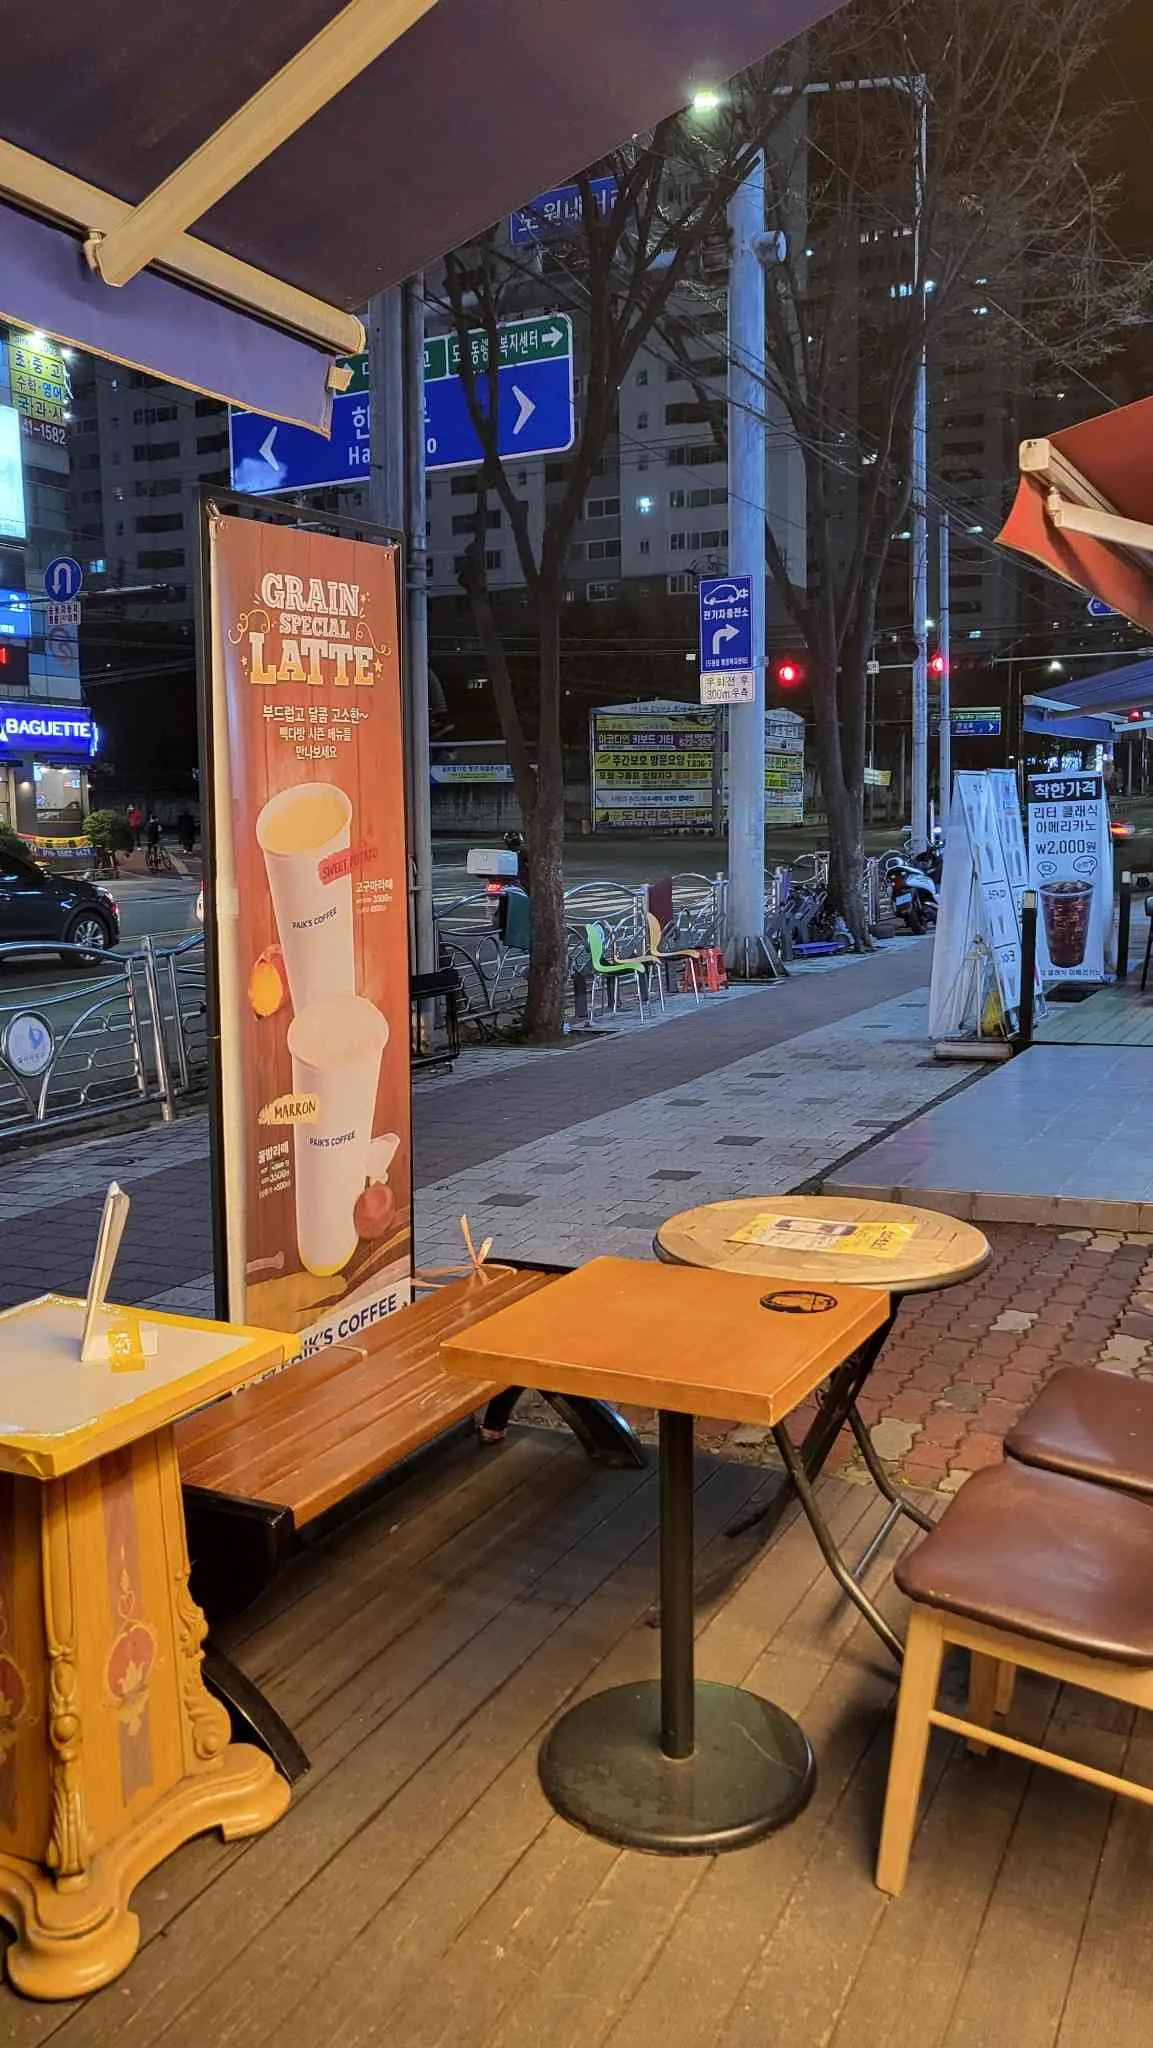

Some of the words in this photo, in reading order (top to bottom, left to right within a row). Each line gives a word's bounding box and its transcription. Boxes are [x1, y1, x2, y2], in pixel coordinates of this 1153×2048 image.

[452, 329, 539, 364] 도동행복지센터
[261, 572, 360, 617] GRAIN
[279, 612, 351, 639] SPECIAL
[248, 631, 375, 687] LATTE
[262, 704, 305, 723] 부드럽고
[308, 705, 329, 724] 달콤
[5, 718, 92, 737] BAGUETTE
[295, 745, 338, 760] 만나보세요
[613, 754, 648, 767] 주간보호
[1033, 780, 1097, 799] 착한가격
[1033, 806, 1057, 820] 리터
[1062, 804, 1099, 819] 클래식
[1035, 819, 1097, 834] 아메리카노
[322, 858, 347, 880] SWEET
[314, 905, 337, 926] COFFEE
[274, 1100, 317, 1120] MARRON
[330, 1130, 356, 1147] COFFEE
[338, 1292, 398, 1339] COFFEE
